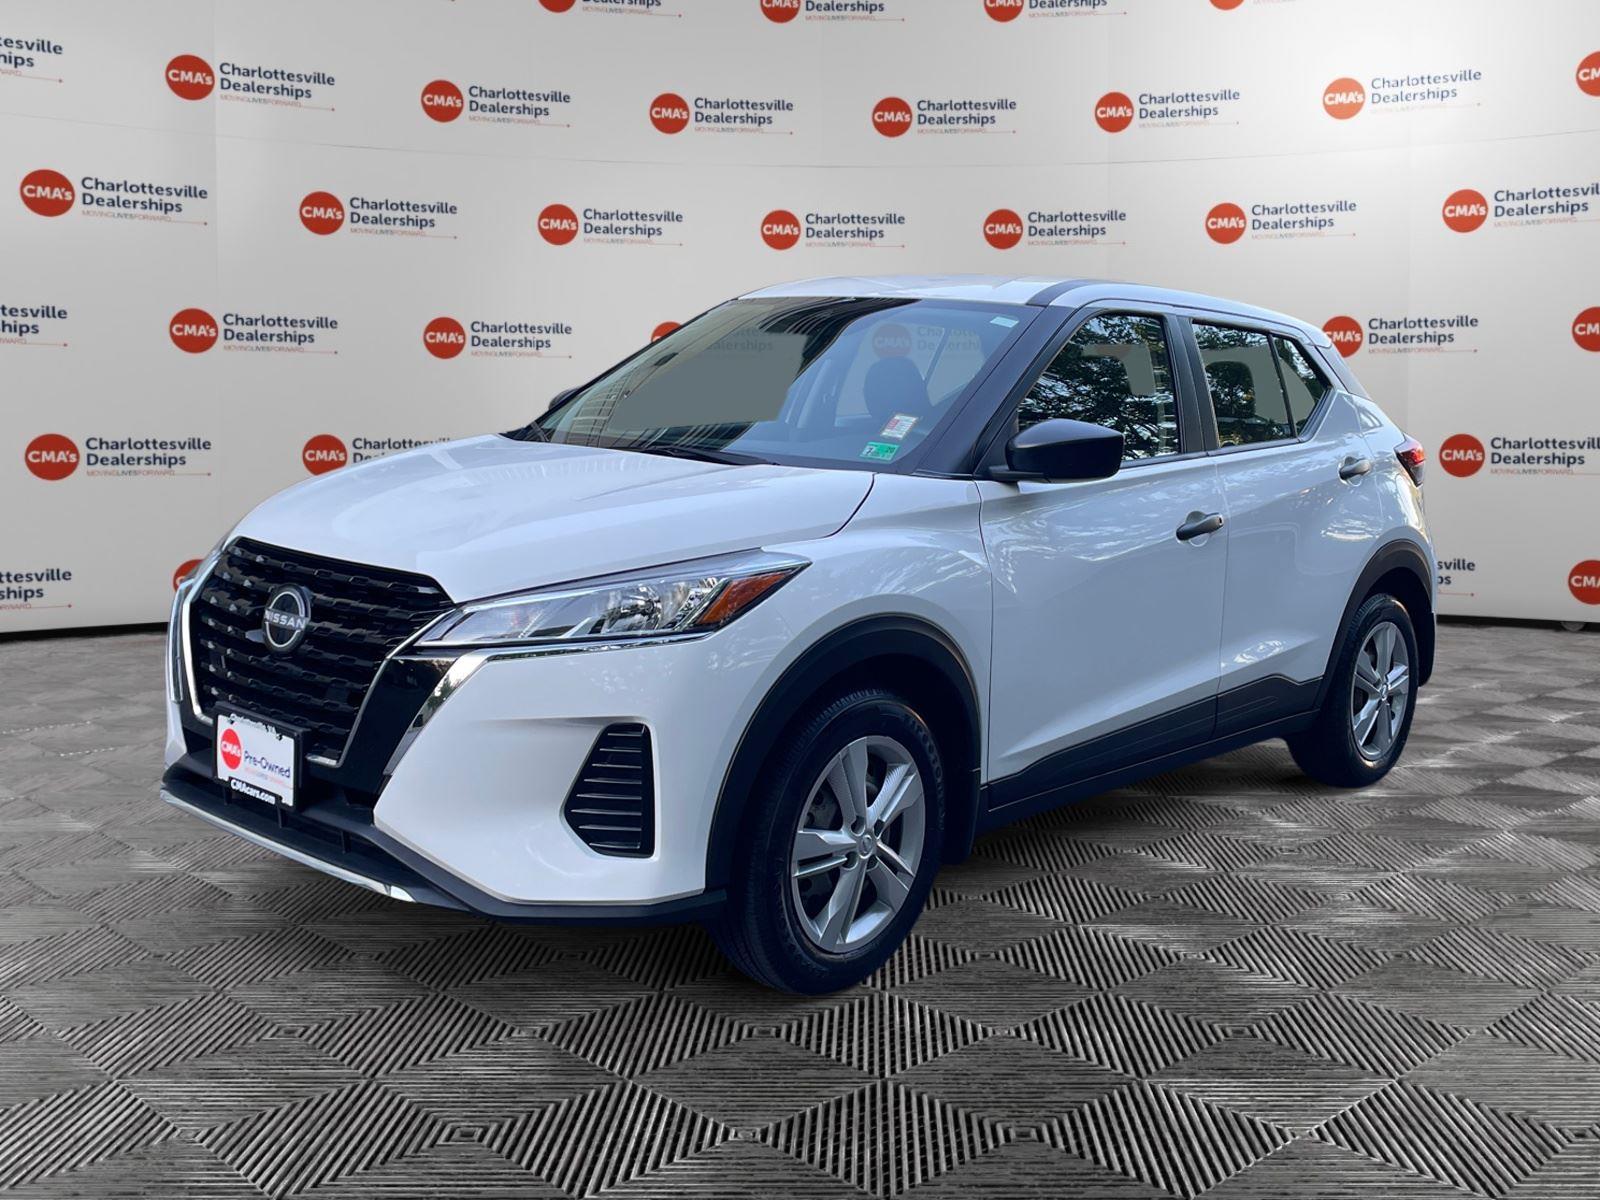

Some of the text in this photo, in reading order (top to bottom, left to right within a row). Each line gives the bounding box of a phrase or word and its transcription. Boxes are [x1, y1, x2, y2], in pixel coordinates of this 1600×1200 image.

[805, 0, 885, 15] Dealerships
[1028, 0, 1108, 10] Dealerships
[168, 69, 213, 85] CMA's
[220, 63, 335, 86] Charlottesville
[1371, 69, 1482, 90] Charlottesville
[220, 78, 312, 101] Dealerships
[468, 86, 571, 104] Charlottesville
[1138, 89, 1240, 105] Charlottesville
[1371, 88, 1457, 104] Dealerships
[423, 94, 461, 107] CMA's
[694, 97, 793, 111] Charlottesville
[917, 99, 1017, 112] Charlottesville
[1325, 91, 1363, 105] CMA's
[468, 100, 550, 118] Dealerships
[652, 107, 687, 119] CMA's
[1097, 106, 1131, 118] CMA's
[1138, 105, 1219, 120] Dealerships
[694, 111, 773, 127] Dealerships
[875, 111, 910, 123] CMA's
[917, 113, 996, 128] Dealerships
[22, 184, 73, 200] CMA's
[80, 177, 208, 199] Charlottesville
[81, 193, 183, 215] Dealerships
[349, 197, 458, 214] Charlottesville
[1251, 200, 1357, 215] Charlottesville
[1445, 203, 1486, 218] CMA's
[1494, 200, 1589, 217] Dealerships
[302, 205, 342, 220] CMA's
[582, 208, 683, 222] Charlottesville
[805, 212, 906, 225] Charlottesville
[1027, 210, 1127, 223] Charlottesville
[350, 212, 436, 231] Dealerships
[540, 218, 577, 230] CMA's
[986, 223, 1021, 235] CMA's
[1208, 216, 1243, 229] CMA's
[1251, 216, 1335, 231] Dealerships
[583, 223, 663, 239] Dealerships
[763, 223, 798, 236] CMA's
[805, 227, 885, 241] Dealerships
[1028, 225, 1107, 239] Dealerships
[222, 313, 338, 330] Charlottesville
[470, 321, 573, 334] Charlottesville
[1368, 314, 1479, 330] Charlottesville
[171, 323, 216, 337] CMA's
[223, 328, 315, 346] Dealerships
[426, 331, 464, 344] CMA's
[471, 335, 552, 351] Dealerships
[1368, 331, 1455, 346] Dealerships
[85, 437, 212, 451] Charlottesville
[27, 450, 78, 463] CMA's
[86, 453, 187, 469] Dealerships
[304, 450, 346, 462] CMA's
[1441, 449, 1483, 462] CMA's
[1490, 452, 1585, 469] Dealerships
[264, 610, 306, 629] NISSAN
[244, 750, 291, 778] Pre-Owned
